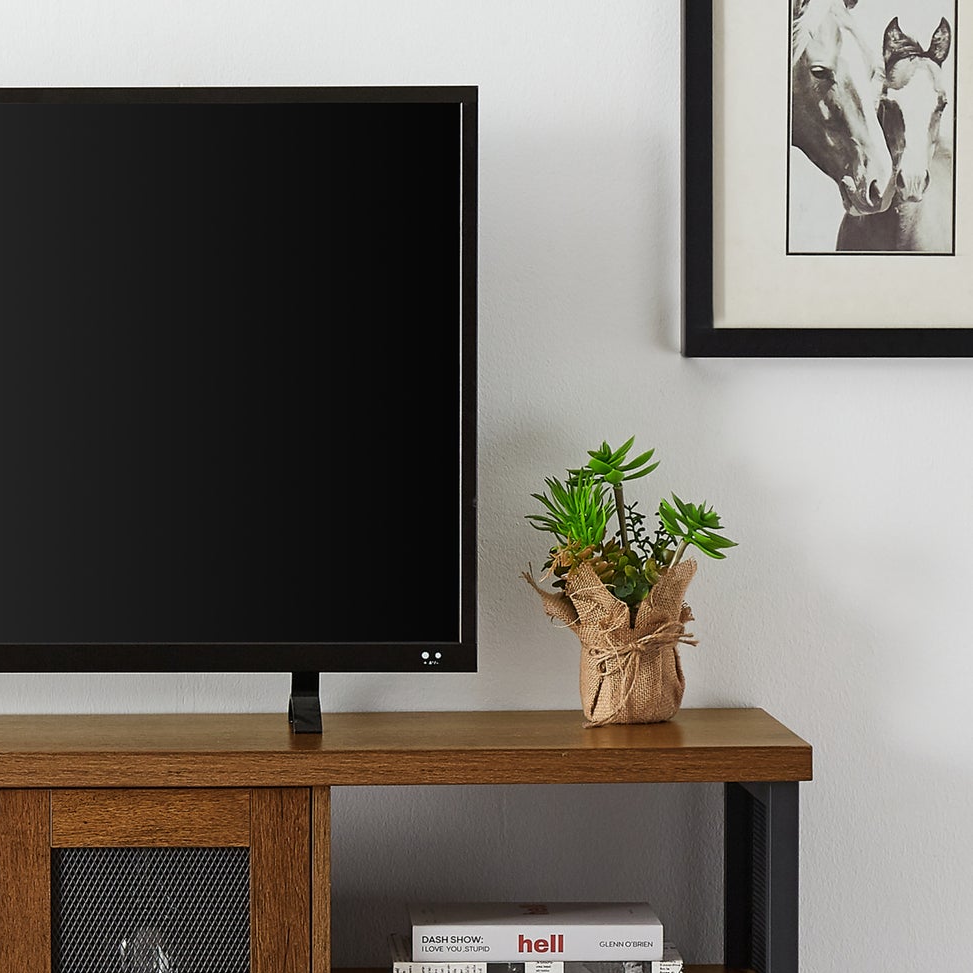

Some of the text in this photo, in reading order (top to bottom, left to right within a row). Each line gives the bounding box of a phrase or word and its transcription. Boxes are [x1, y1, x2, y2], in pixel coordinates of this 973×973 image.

[421, 935, 484, 944] DASH SHOW:
[518, 934, 564, 953] hell
[599, 940, 654, 948] GLENN O'BRIEN
[425, 945, 444, 953] LOVE
[446, 945, 462, 953] YOU
